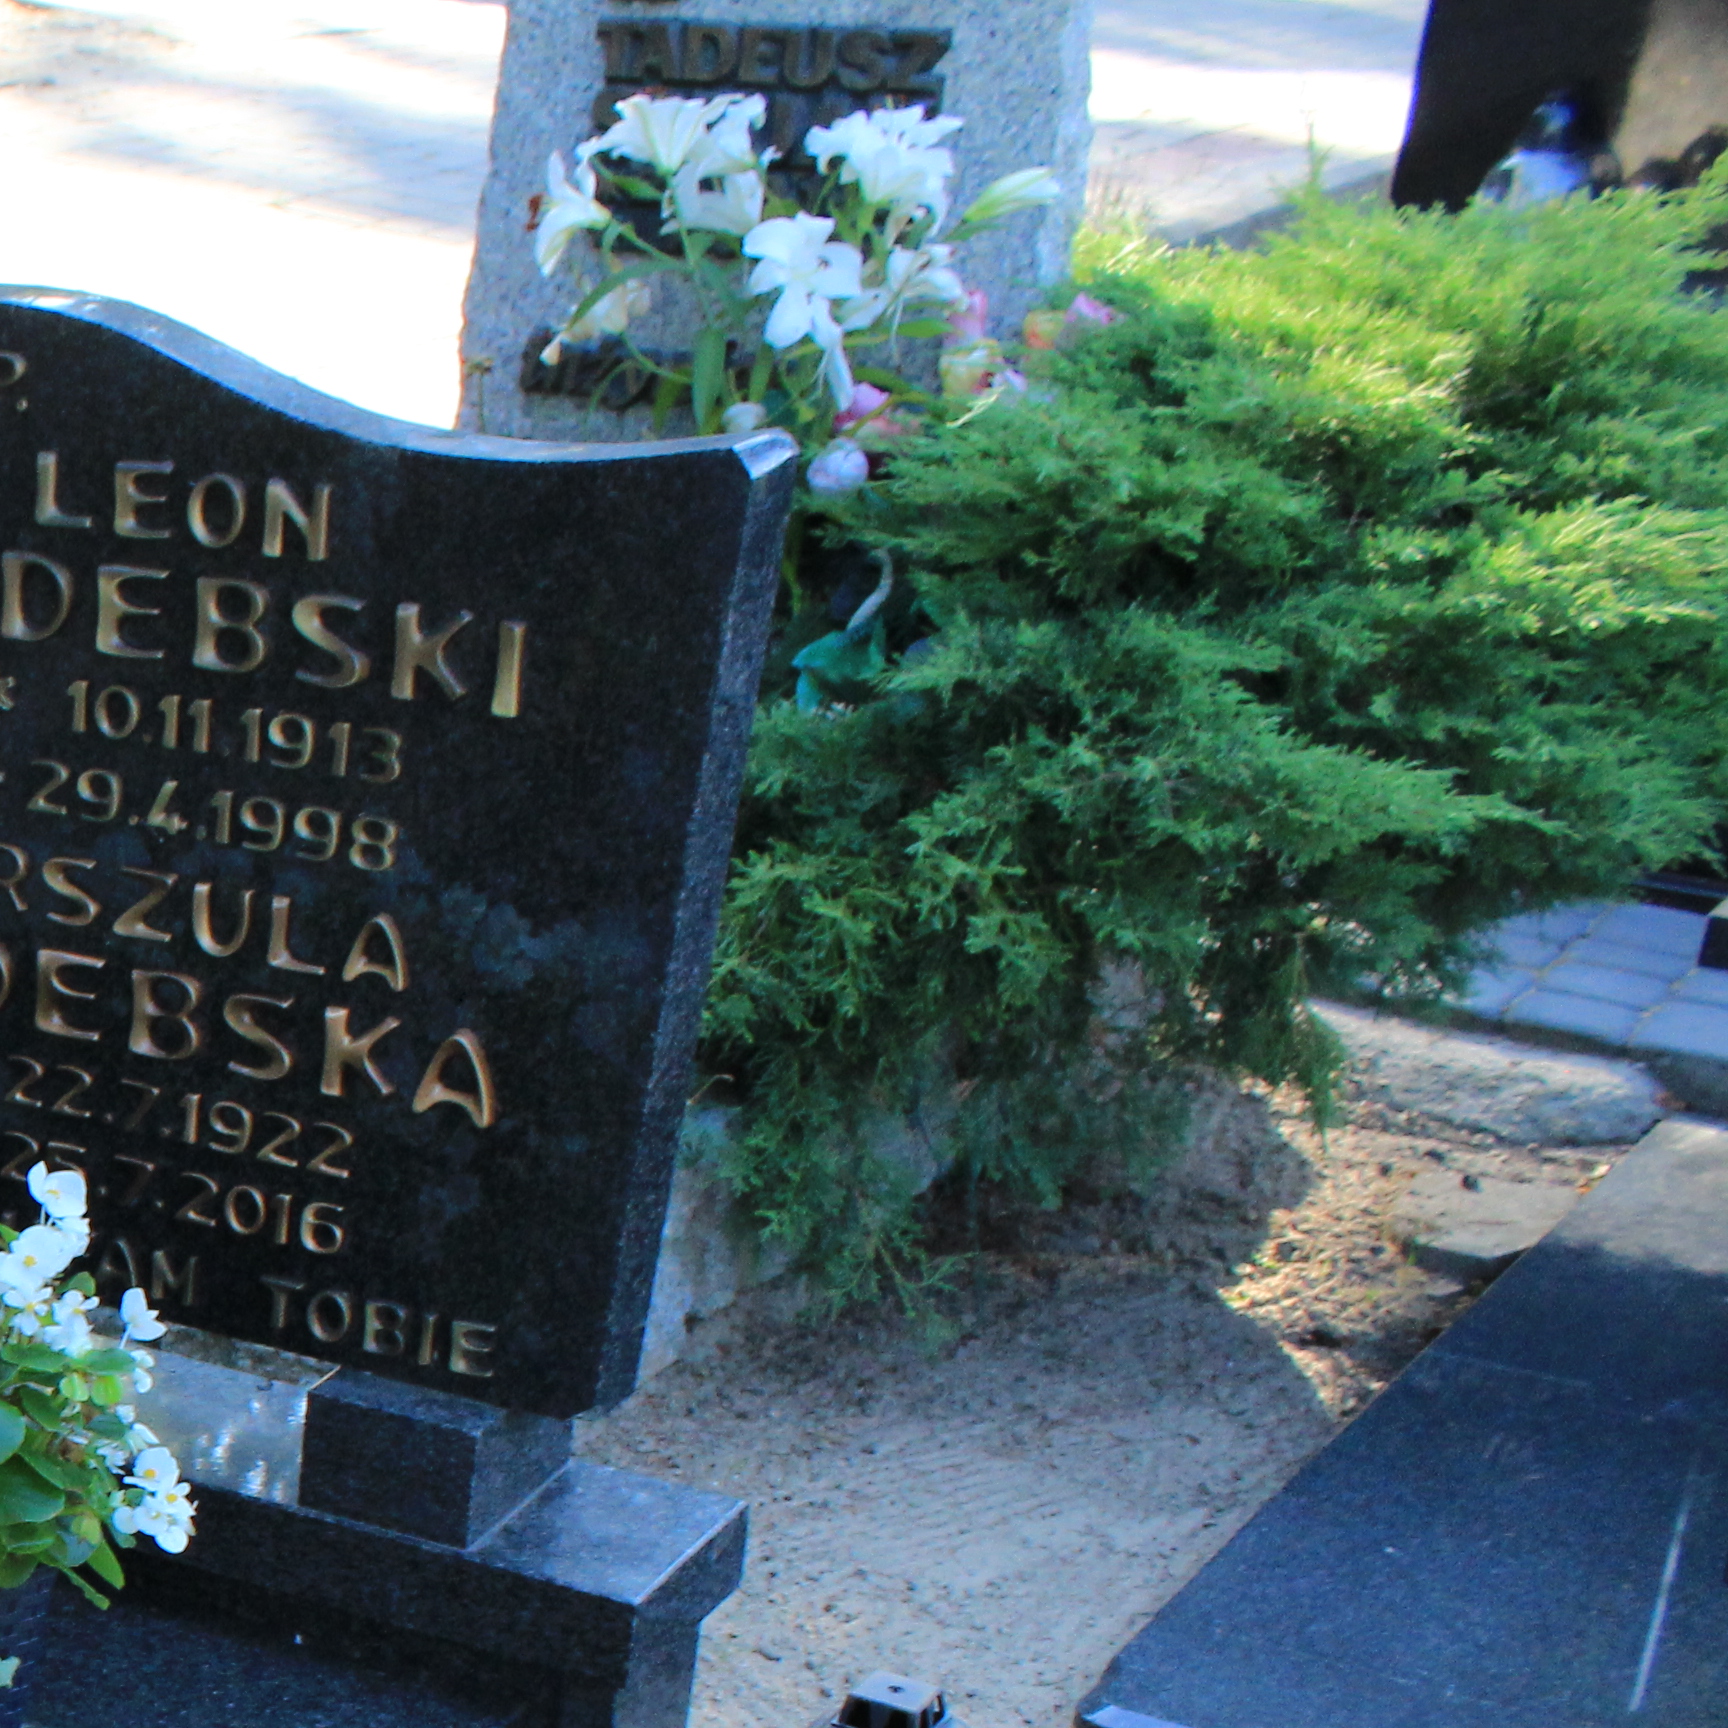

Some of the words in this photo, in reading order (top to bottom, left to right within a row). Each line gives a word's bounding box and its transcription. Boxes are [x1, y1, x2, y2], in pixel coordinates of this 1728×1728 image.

[596, 18, 952, 93] TADEUSZ
[34, 450, 334, 562] LEON
[66, 679, 403, 784] 10.11.1913
[26, 758, 399, 871] 29.4.1998
[5, 1055, 351, 1179] 22.7.1922
[260, 1273, 499, 1378] TOBIE
